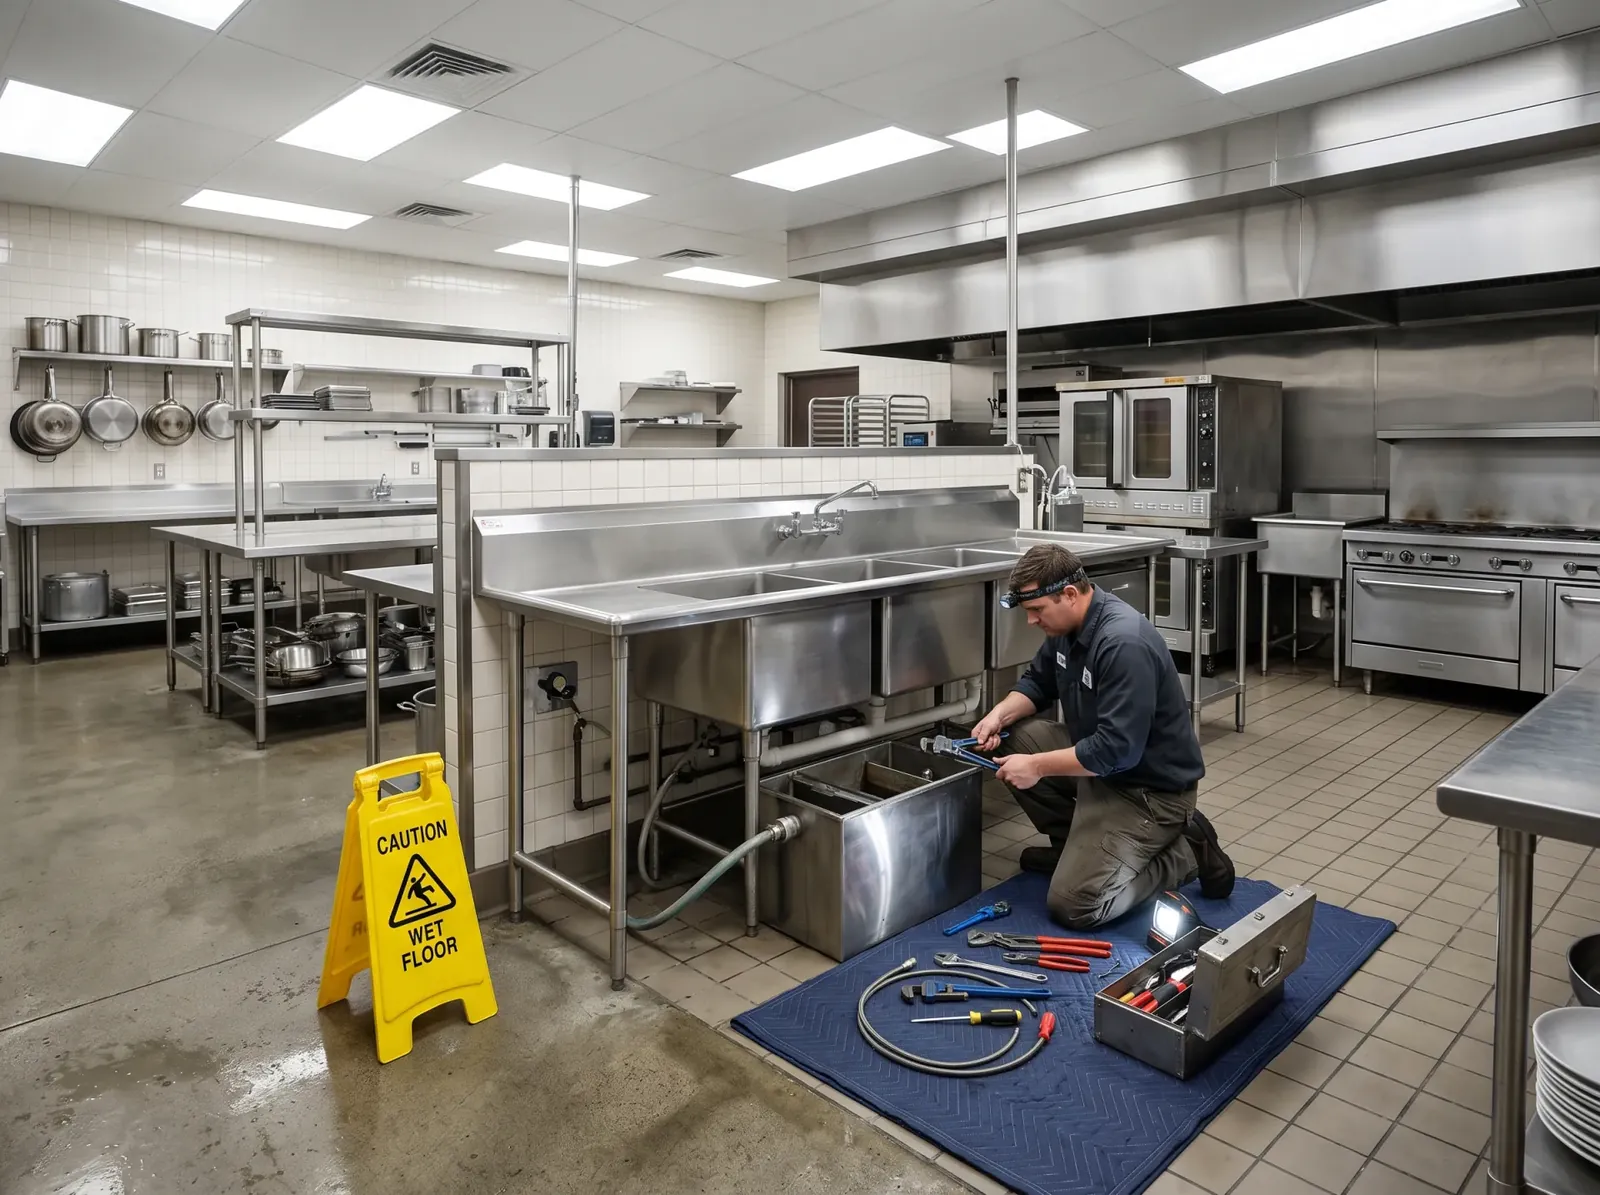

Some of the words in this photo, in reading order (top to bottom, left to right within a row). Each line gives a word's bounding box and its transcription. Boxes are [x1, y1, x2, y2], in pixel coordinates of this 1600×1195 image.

[377, 819, 448, 855] CAUTION
[408, 919, 444, 946] WET
[401, 936, 458, 972] FLOOR
